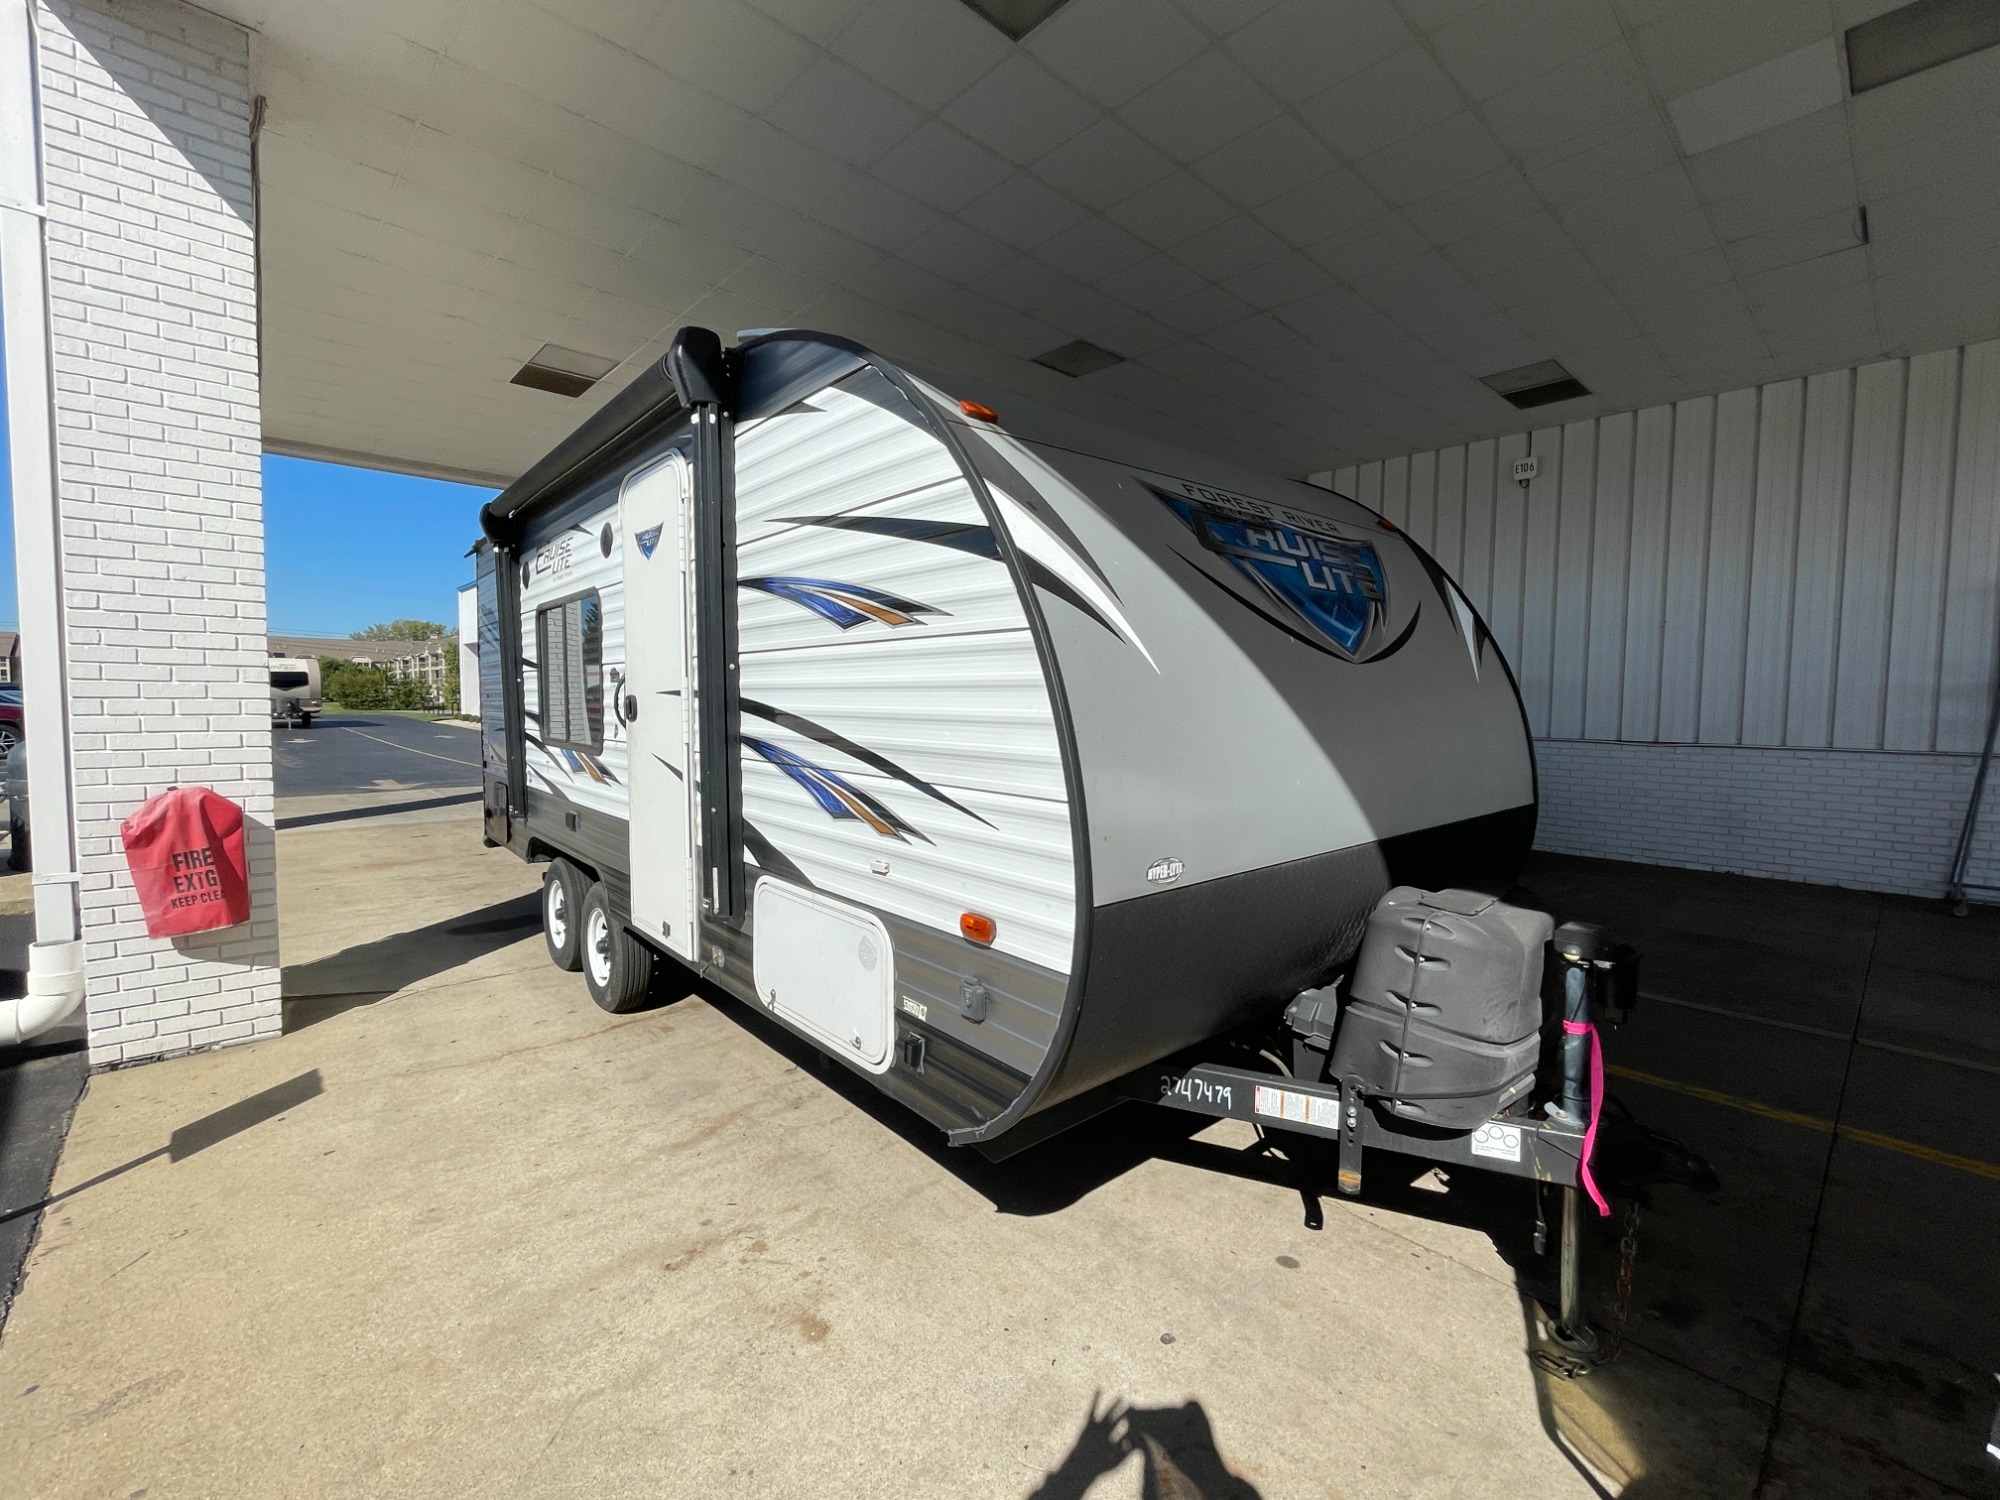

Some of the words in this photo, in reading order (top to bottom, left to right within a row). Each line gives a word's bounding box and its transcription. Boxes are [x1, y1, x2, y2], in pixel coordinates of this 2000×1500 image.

[1515, 462, 1535, 474] E106
[1181, 483, 1275, 517] FOREST
[1281, 510, 1343, 535] RIVER
[1190, 510, 1374, 569] CRUISE
[536, 536, 573, 575] CRUISE
[552, 553, 573, 575] LITE
[1301, 561, 1384, 602] LITE
[172, 847, 215, 872] FIRE
[173, 869, 218, 894] EXTG
[170, 895, 198, 909] KEEP
[1160, 1075, 1232, 1111] 2747479
